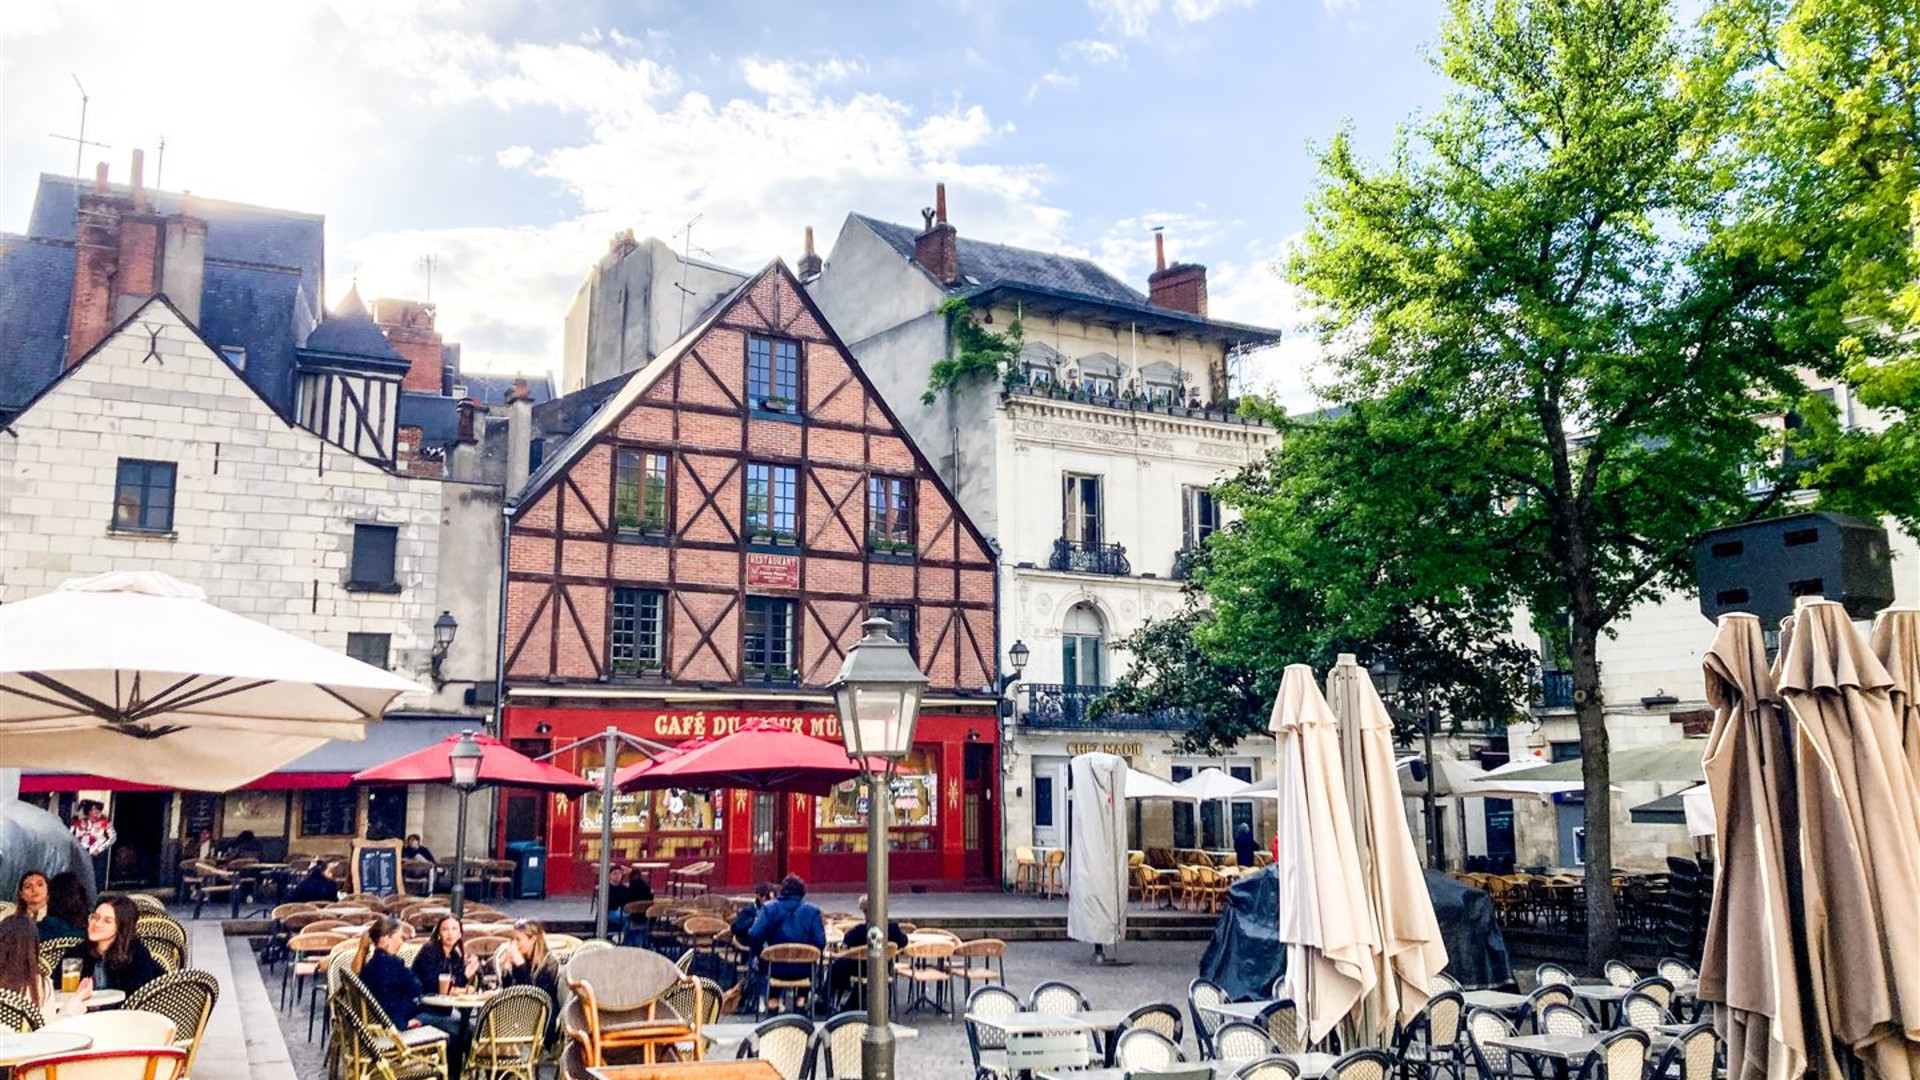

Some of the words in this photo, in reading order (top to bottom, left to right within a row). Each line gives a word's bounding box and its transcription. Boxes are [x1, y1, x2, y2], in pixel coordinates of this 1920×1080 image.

[750, 554, 797, 566] RESTAURANT
[655, 711, 705, 736] CAFÉ
[712, 715, 741, 736] DU
[1067, 742, 1099, 756] CHEZ
